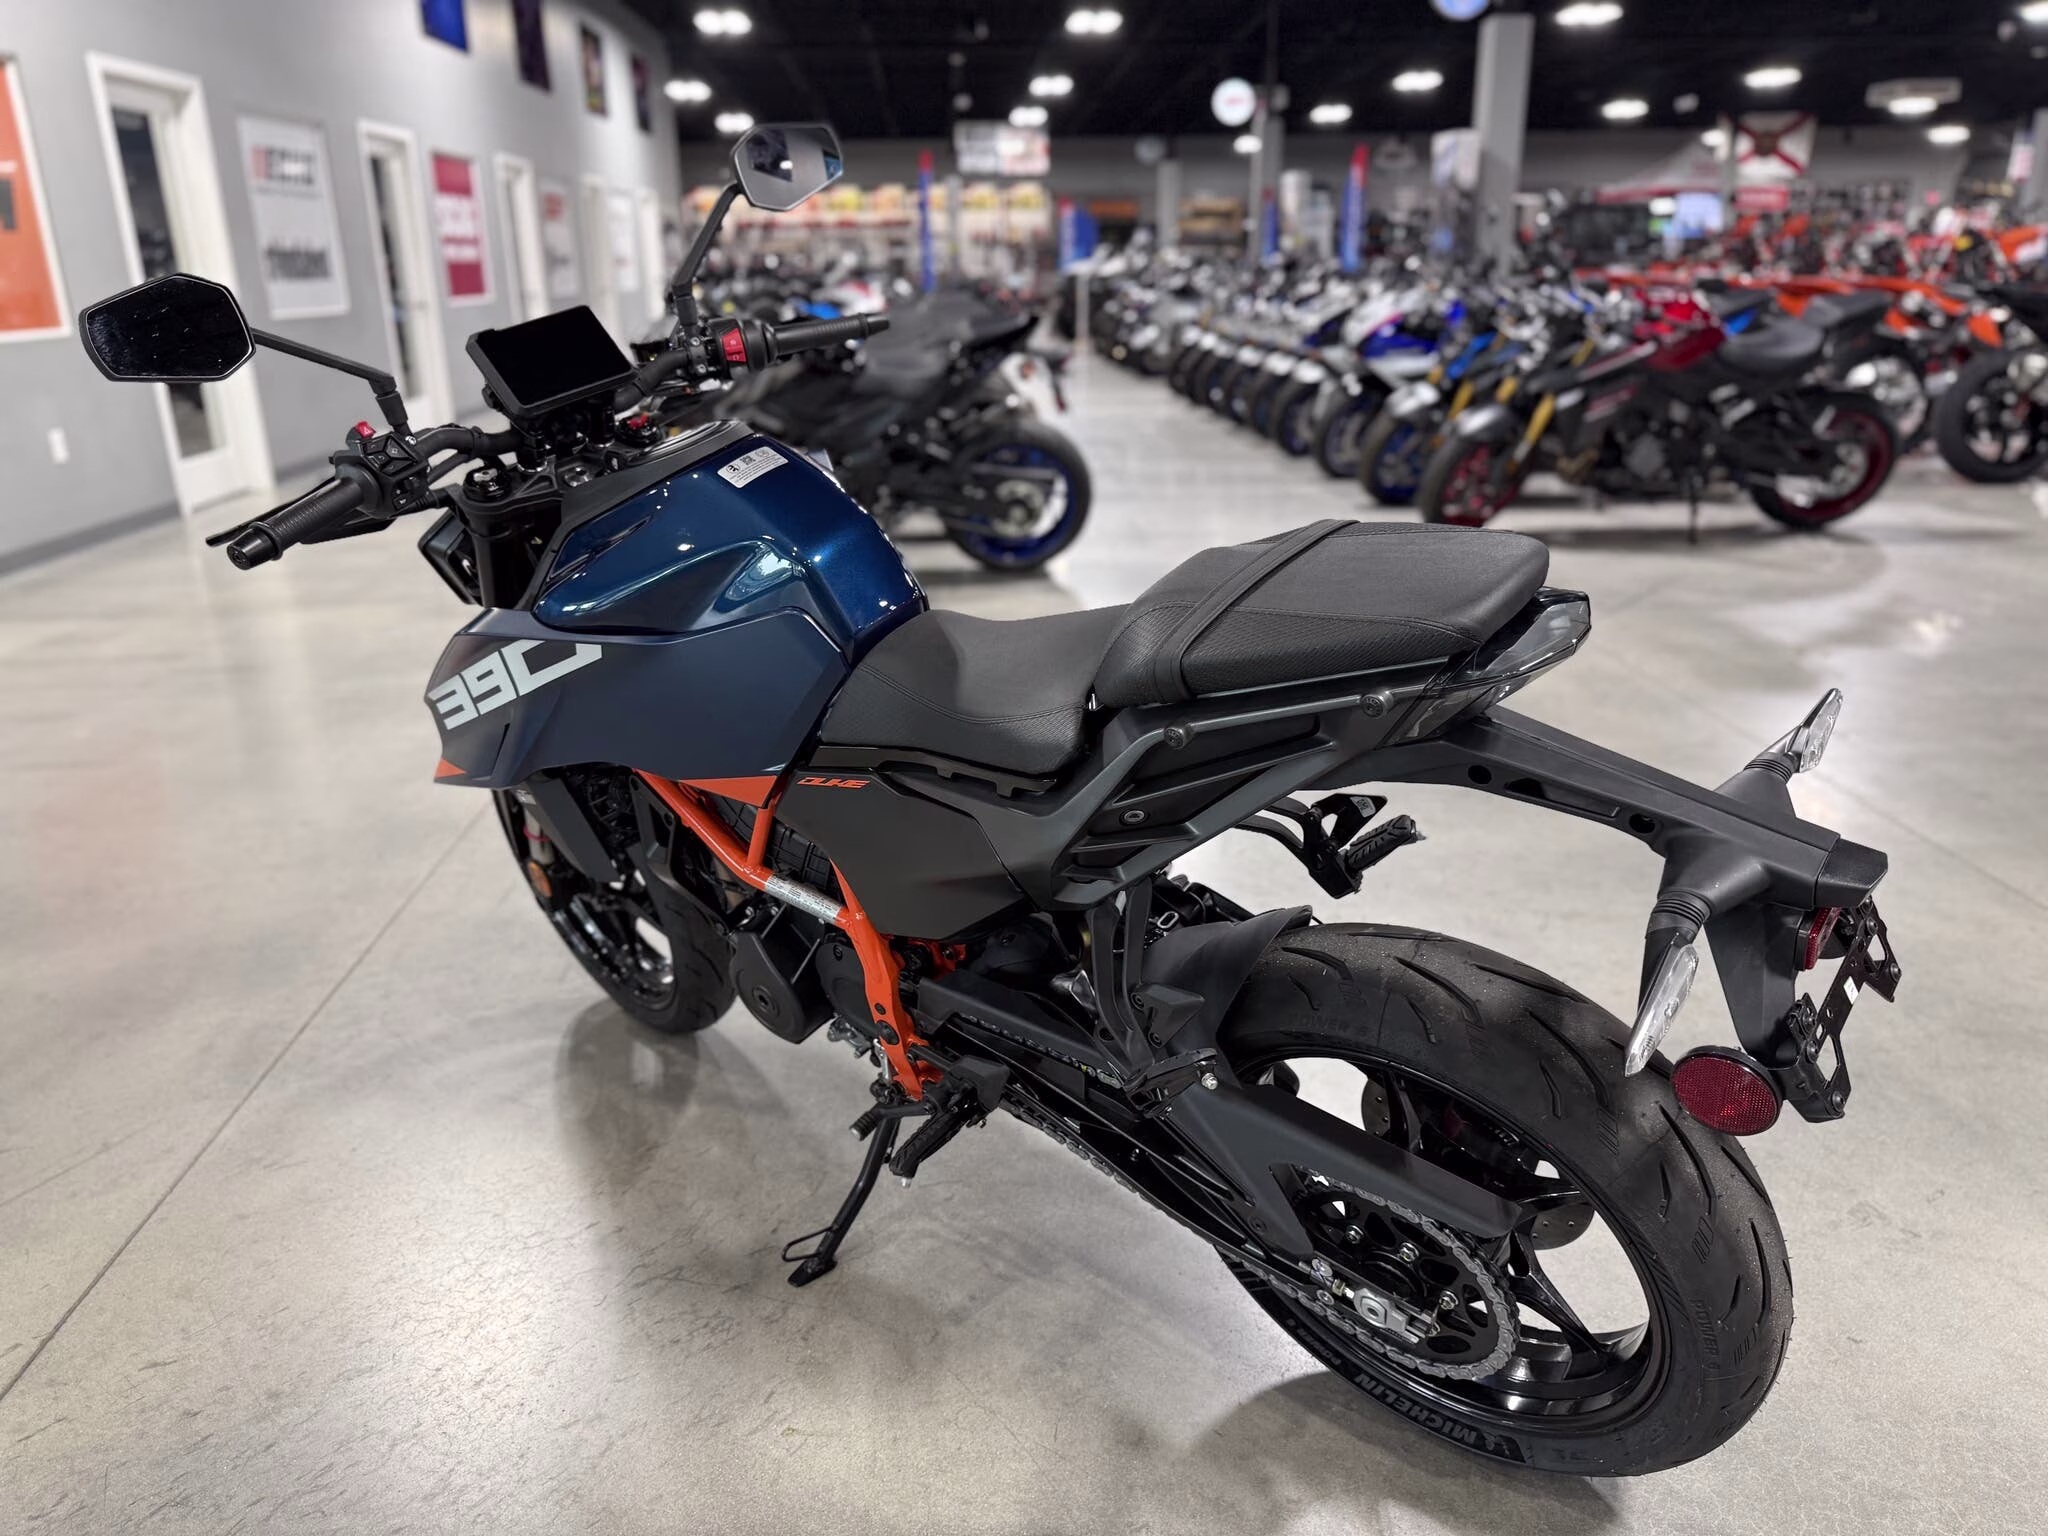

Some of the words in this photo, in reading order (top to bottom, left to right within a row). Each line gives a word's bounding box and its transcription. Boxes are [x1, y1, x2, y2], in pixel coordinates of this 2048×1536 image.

[427, 638, 603, 730] 390
[796, 776, 871, 789] DUKE
[1689, 1300, 1719, 1357] POWER
[1354, 1373, 1478, 1445] MICHELIN
